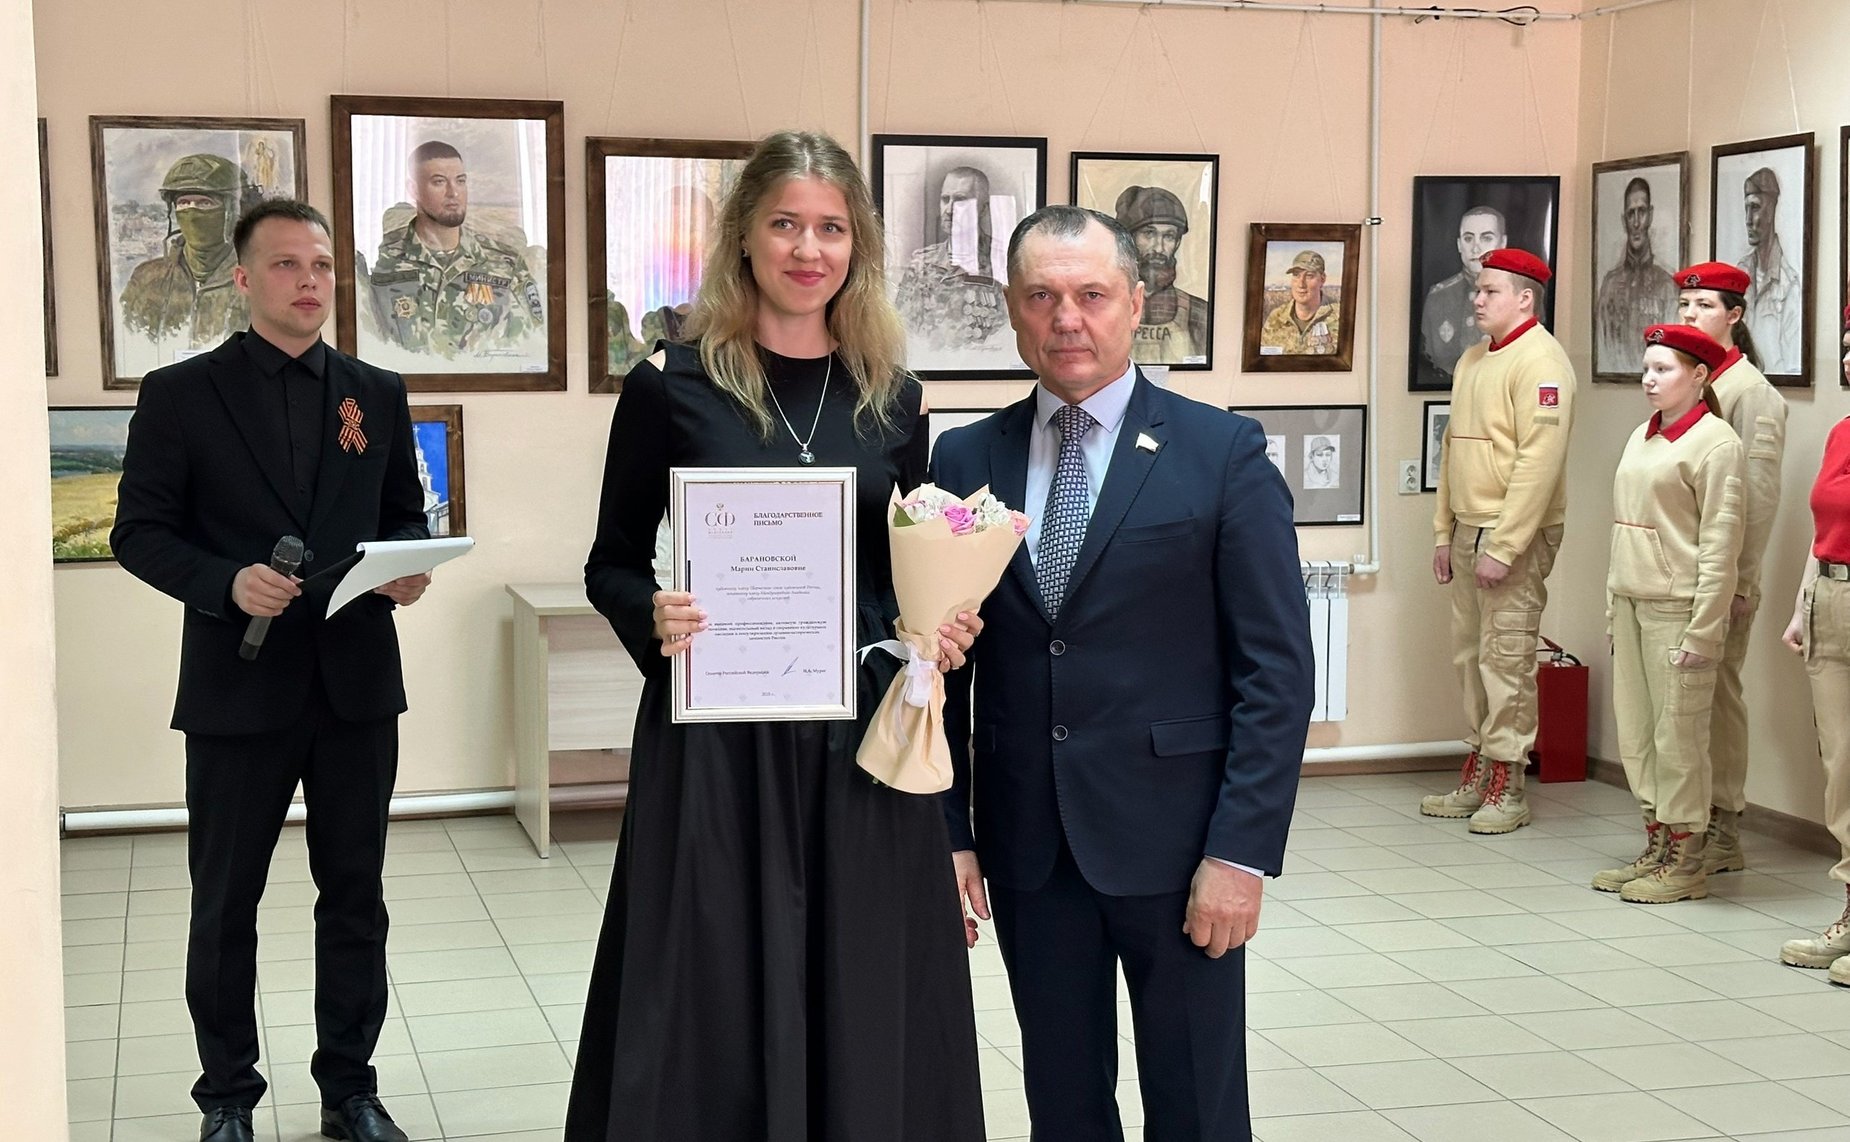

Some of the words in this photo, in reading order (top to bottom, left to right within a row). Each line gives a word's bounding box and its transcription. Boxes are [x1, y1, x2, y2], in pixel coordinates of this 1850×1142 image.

[1132, 327, 1171, 340] РЕССА
[753, 511, 823, 519] БЛАГОДАРСТВЕННОЕ
[753, 519, 783, 527] ПИСЬМО
[740, 554, 797, 563] БАРАНОВСКОЙ
